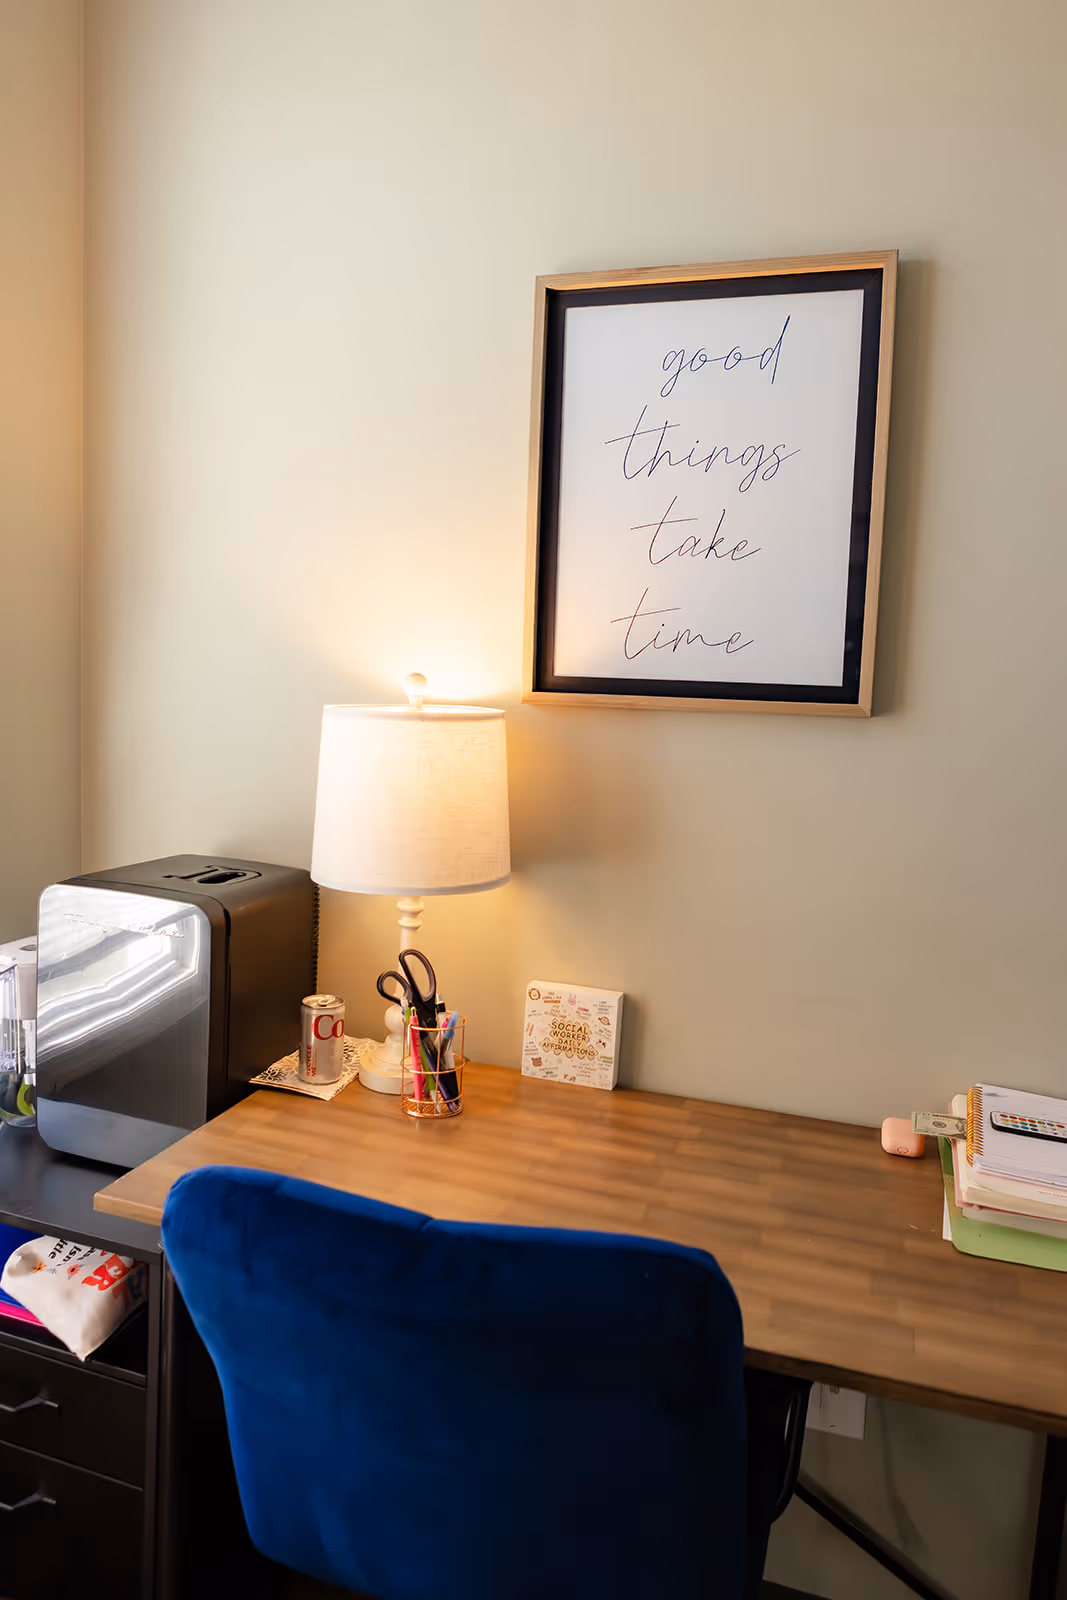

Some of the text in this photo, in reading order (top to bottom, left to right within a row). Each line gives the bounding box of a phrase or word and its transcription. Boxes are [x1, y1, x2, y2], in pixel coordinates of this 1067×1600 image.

[660, 315, 790, 398] good
[604, 405, 801, 492] things
[630, 496, 761, 565] take
[610, 587, 754, 660] time
[551, 1021, 588, 1035] SOCIAL
[552, 1030, 587, 1042] WORKER
[558, 1038, 582, 1047] DAILY
[542, 1042, 595, 1057] AFFIRMATIONS
